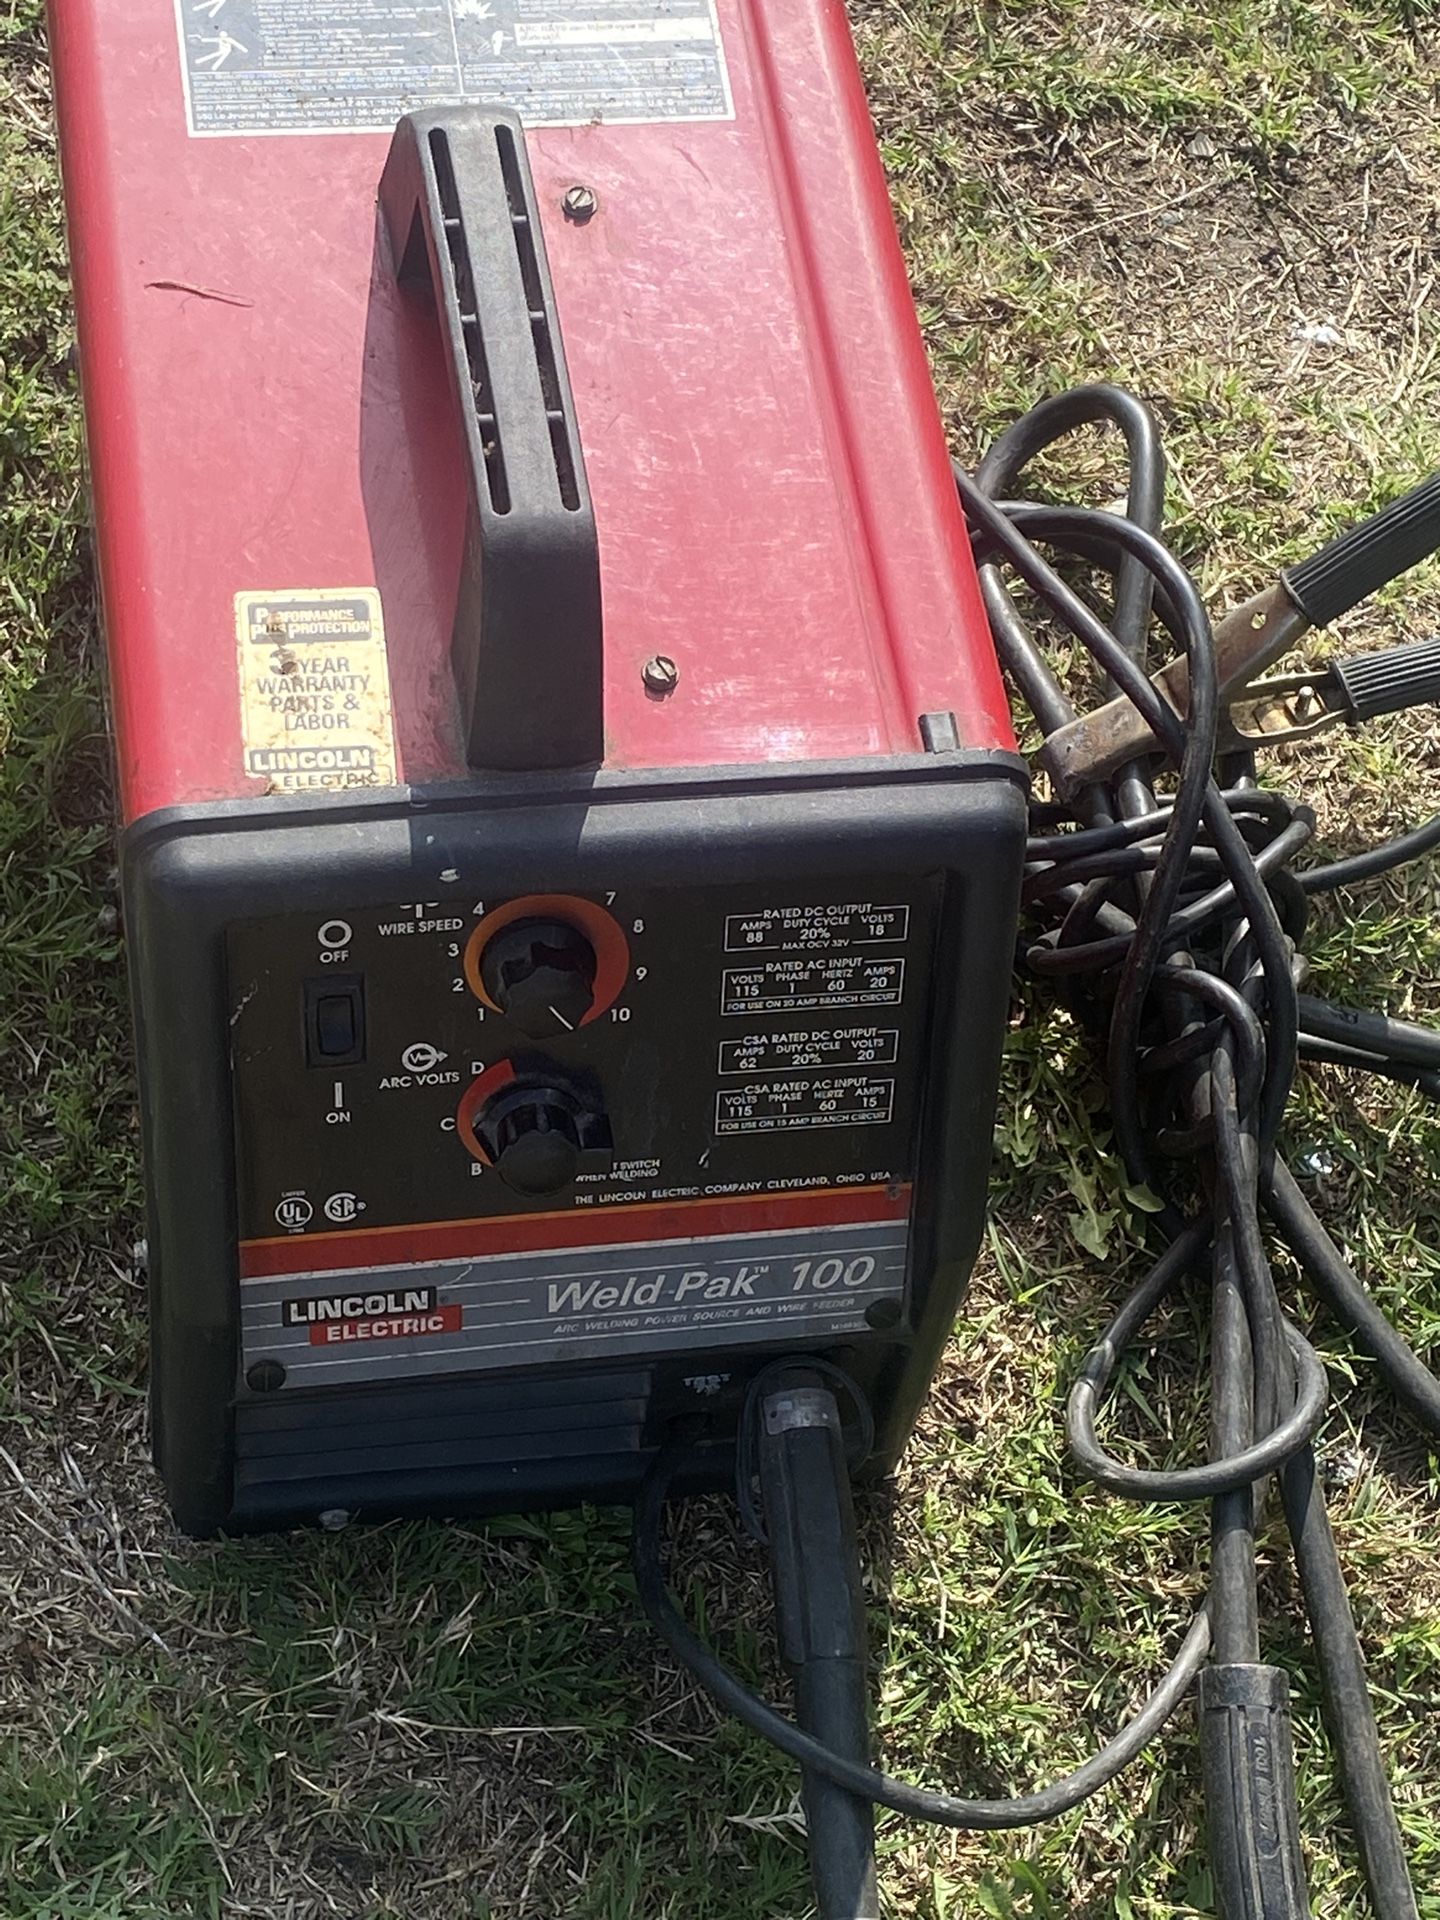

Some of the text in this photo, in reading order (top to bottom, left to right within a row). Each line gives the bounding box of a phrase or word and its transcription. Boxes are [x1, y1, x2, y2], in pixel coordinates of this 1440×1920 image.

[288, 621, 370, 640] PROTECTION
[301, 657, 349, 674] YEAR
[256, 675, 370, 694] WARRANTY
[270, 694, 360, 713] PARTS &
[284, 714, 349, 731] LABOR
[253, 750, 370, 771] LINCOLN
[283, 772, 379, 787] ELECTRIC
[605, 892, 616, 905] 7
[472, 902, 484, 916] 4
[764, 903, 872, 919] RATED DC OUTPUT
[378, 918, 463, 936] WIRE SPEED
[633, 919, 644, 934] 8
[740, 913, 894, 931] AMPS DUTY CYCLE VOLTS
[800, 927, 831, 940] 20%
[869, 924, 884, 936] 18
[319, 950, 349, 963] OFF
[448, 944, 459, 957] 3
[636, 967, 647, 980] 9
[766, 957, 863, 972] RATED AC INPUT
[731, 965, 896, 985] VOLTS PHASE HERTZ AMPS
[452, 979, 464, 992] 2
[735, 977, 888, 997] 115 1 60 20
[765, 999, 781, 1009] ON
[797, 997, 817, 1007] AMP
[819, 994, 858, 1005] BRANCH
[860, 992, 896, 1003] CIRCUIT
[477, 1008, 484, 1021] 1
[610, 1008, 631, 1022] 10
[742, 1027, 877, 1046] CSA RATED DC OUTPUT
[733, 1038, 884, 1057] AMPS DUTY CYCLE VOLTS
[739, 1050, 875, 1069] 62 20% 20
[472, 1062, 485, 1076] D
[379, 1071, 460, 1090] ARC VOLTS
[744, 1077, 868, 1095] CSA RATED AC INPUT
[724, 1086, 885, 1106] VOLTS PHASE HERTZ AMPS
[728, 1096, 877, 1117] 115 1 60 15
[326, 1111, 350, 1124] ON
[440, 1117, 455, 1131] C
[759, 1119, 774, 1129] ON
[811, 1114, 850, 1125] BRANCH
[851, 1111, 886, 1122] CIRCUIT
[471, 1163, 482, 1176] B
[619, 1159, 660, 1170] SWITCH
[575, 1171, 891, 1204] THE LINCOLN ELECTRIC COMPANY CLEVELAND, OHIO USA
[283, 1203, 306, 1222] UL
[548, 1274, 661, 1313] Weld
[792, 1256, 875, 1291] 100
[290, 1290, 428, 1322] LINCOLN
[554, 1322, 578, 1334] ARC
[584, 1318, 638, 1331] WELDING
[645, 1313, 687, 1326] POWER
[693, 1308, 739, 1321] SOURCE
[746, 1305, 771, 1316] AND
[777, 1302, 807, 1313] WIRE
[327, 1316, 443, 1341] ELECTRIC
